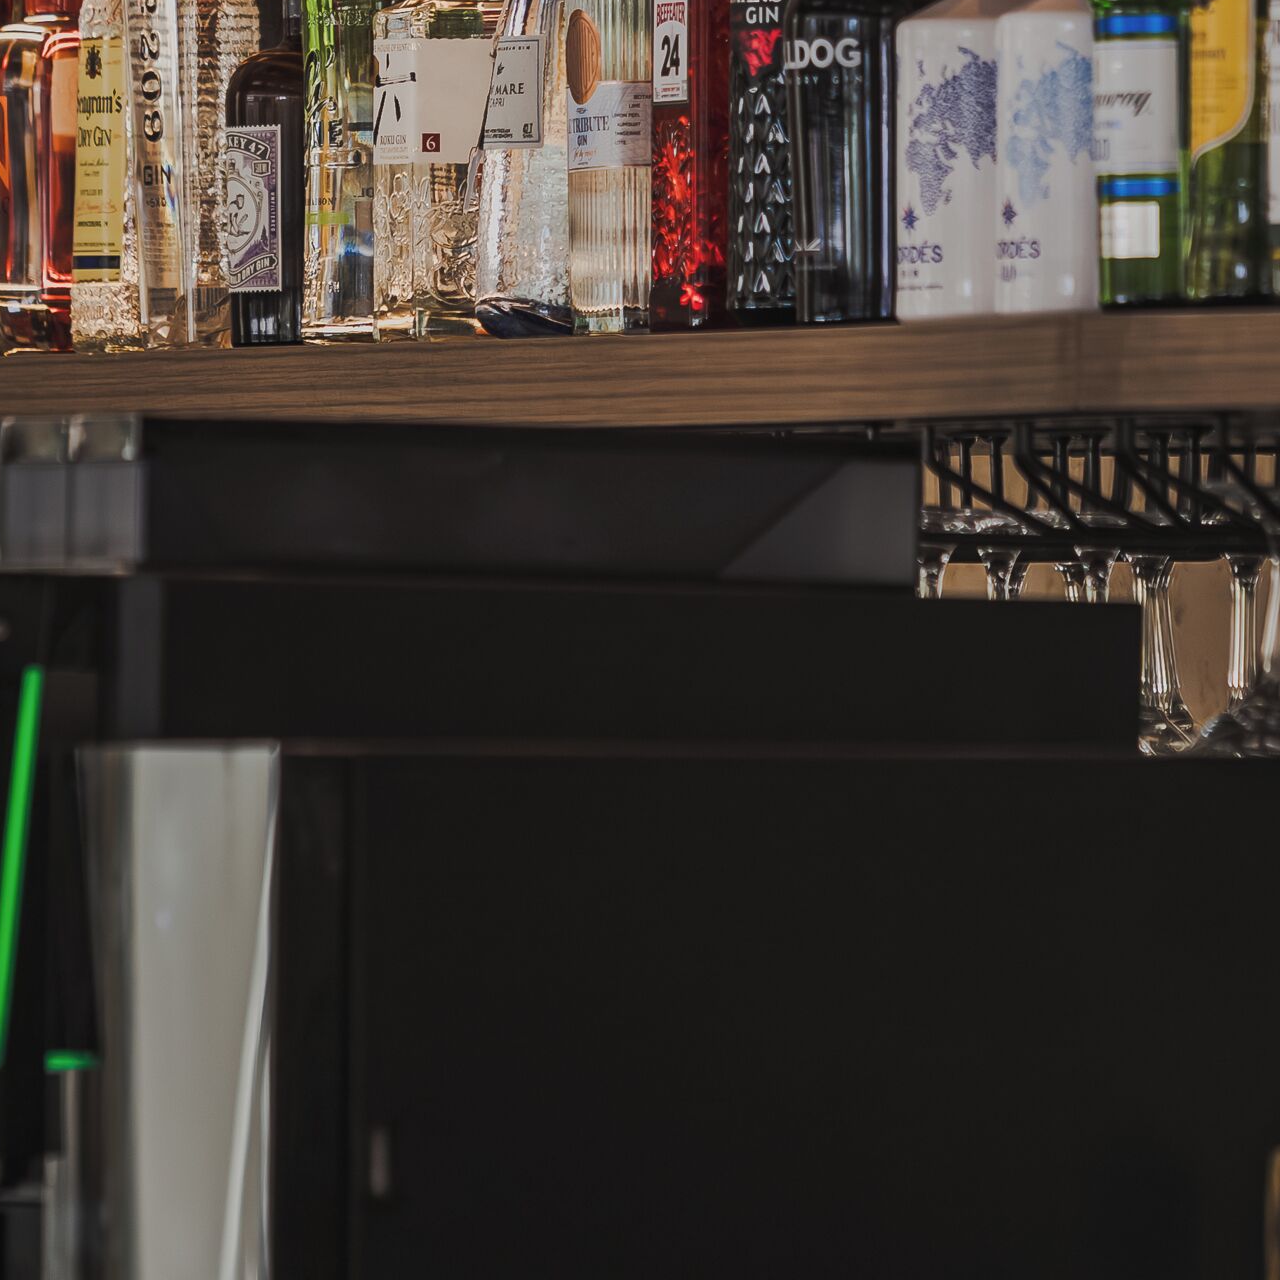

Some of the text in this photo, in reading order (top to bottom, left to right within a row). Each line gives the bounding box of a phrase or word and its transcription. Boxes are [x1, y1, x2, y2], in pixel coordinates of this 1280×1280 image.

[657, 2, 686, 28] BEEFEATER
[745, 6, 779, 24] GIN
[661, 34, 680, 77] 24
[495, 83, 525, 95] MARE
[573, 115, 610, 134] TRIBUTE
[93, 126, 112, 147] GIN
[426, 136, 436, 150] 6
[248, 142, 266, 156] 47
[143, 164, 172, 185] GIN
[255, 256, 270, 271] GIN
